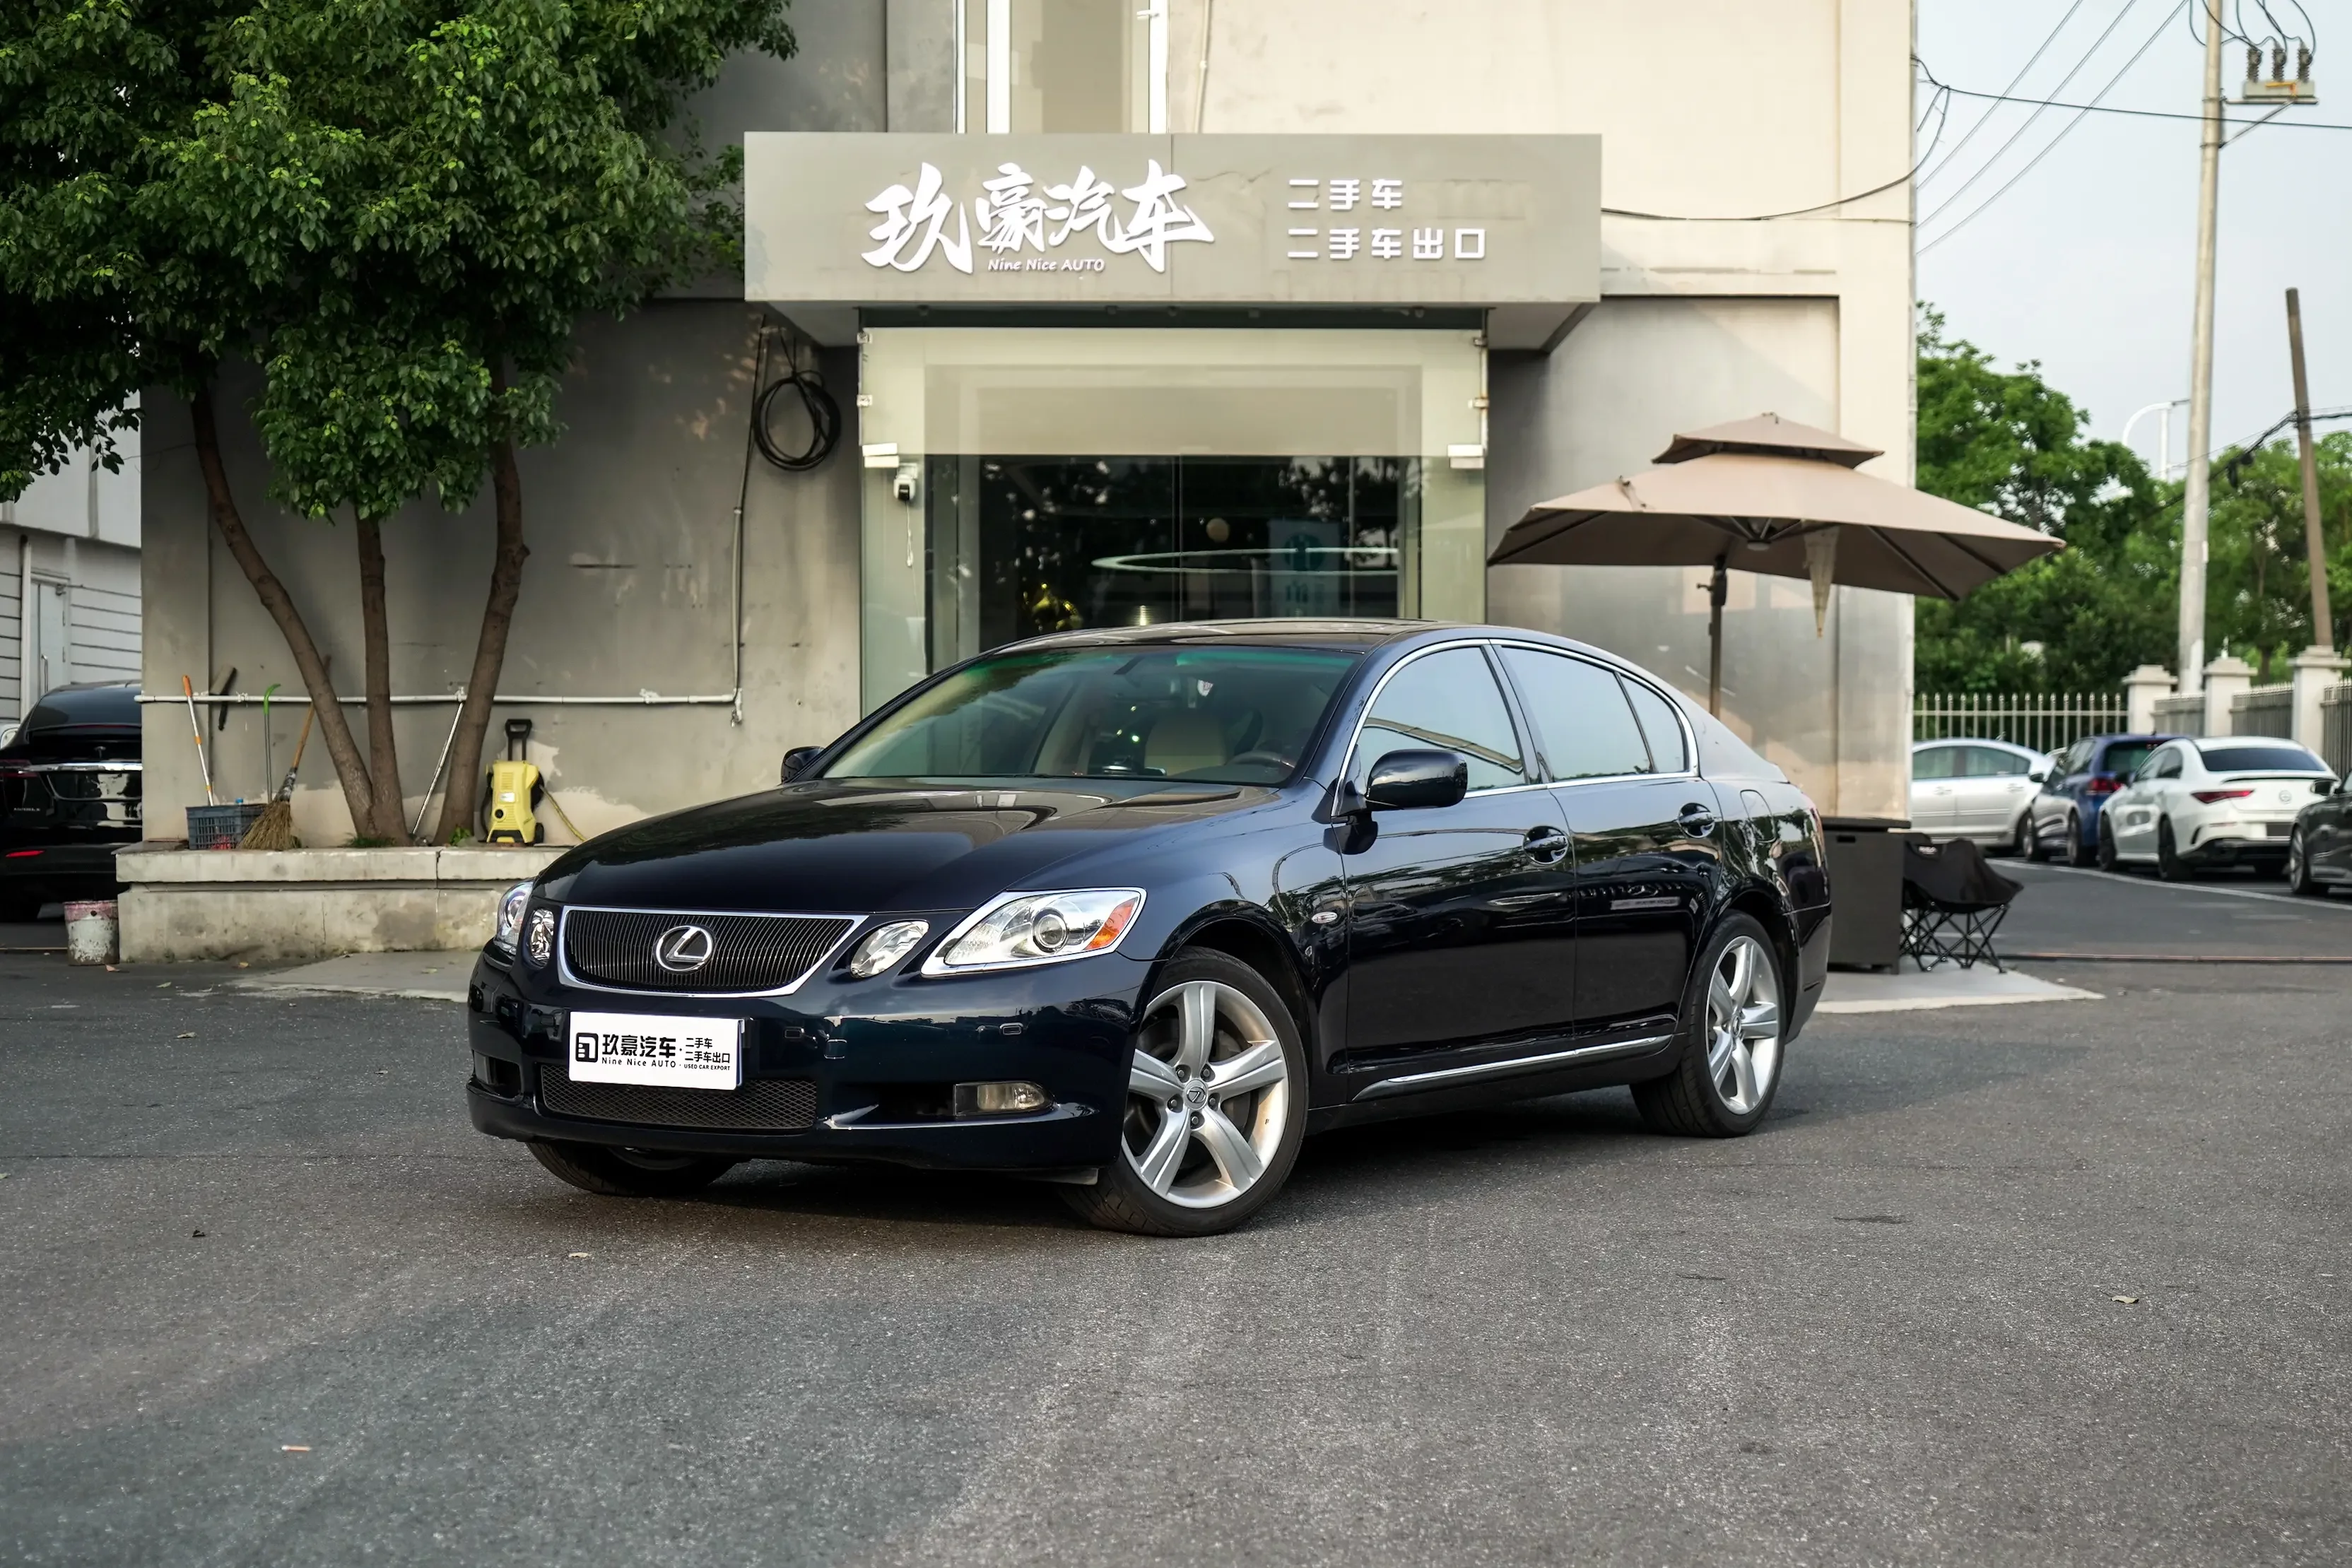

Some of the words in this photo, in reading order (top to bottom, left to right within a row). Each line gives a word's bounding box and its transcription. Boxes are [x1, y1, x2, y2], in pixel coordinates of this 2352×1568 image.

[1288, 178, 1404, 211] 二手车
[862, 160, 1214, 273] 玖豪汽车
[1287, 227, 1487, 260] 二手车出口
[987, 258, 1022, 271] Nine
[1025, 258, 1057, 271] Nice
[1061, 259, 1105, 272] AUTO
[601, 1034, 676, 1059] 玖豪汽车
[685, 1037, 713, 1049] 二手车
[601, 1057, 622, 1066] Nine
[651, 1059, 676, 1068] AUTO
[684, 1051, 731, 1063] 二手车出口
